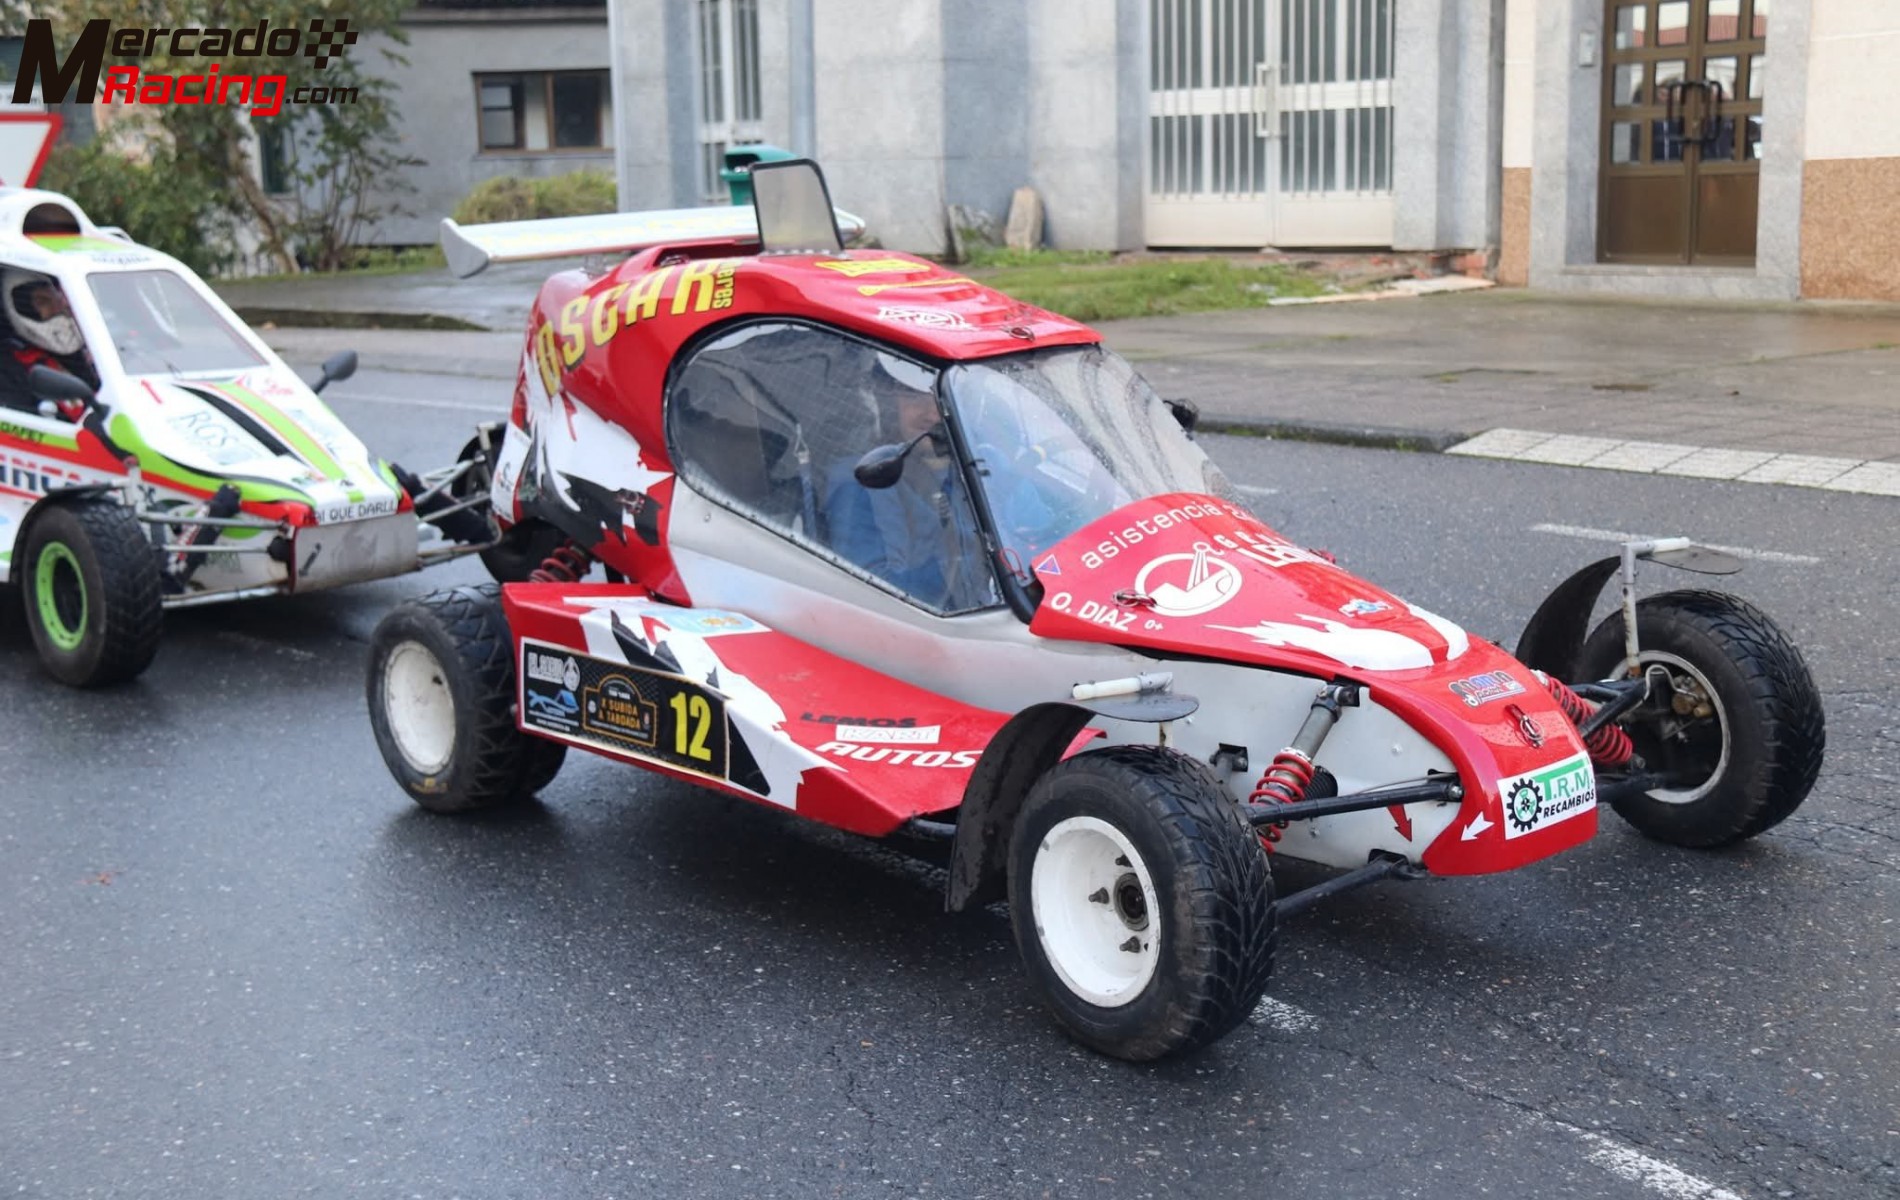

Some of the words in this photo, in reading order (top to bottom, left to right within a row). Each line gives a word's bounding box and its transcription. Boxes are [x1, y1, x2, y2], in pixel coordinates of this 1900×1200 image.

[535, 259, 722, 397] OSCAR
[330, 508, 354, 520] QUE
[1081, 500, 1224, 569] asistencia
[1051, 592, 1073, 614] O.
[1078, 600, 1138, 632] DIAZ
[670, 691, 712, 762] 12
[801, 712, 918, 728] LEMOS
[815, 741, 985, 768] AUTOS
[1543, 789, 1595, 819] RECAMBIOS
